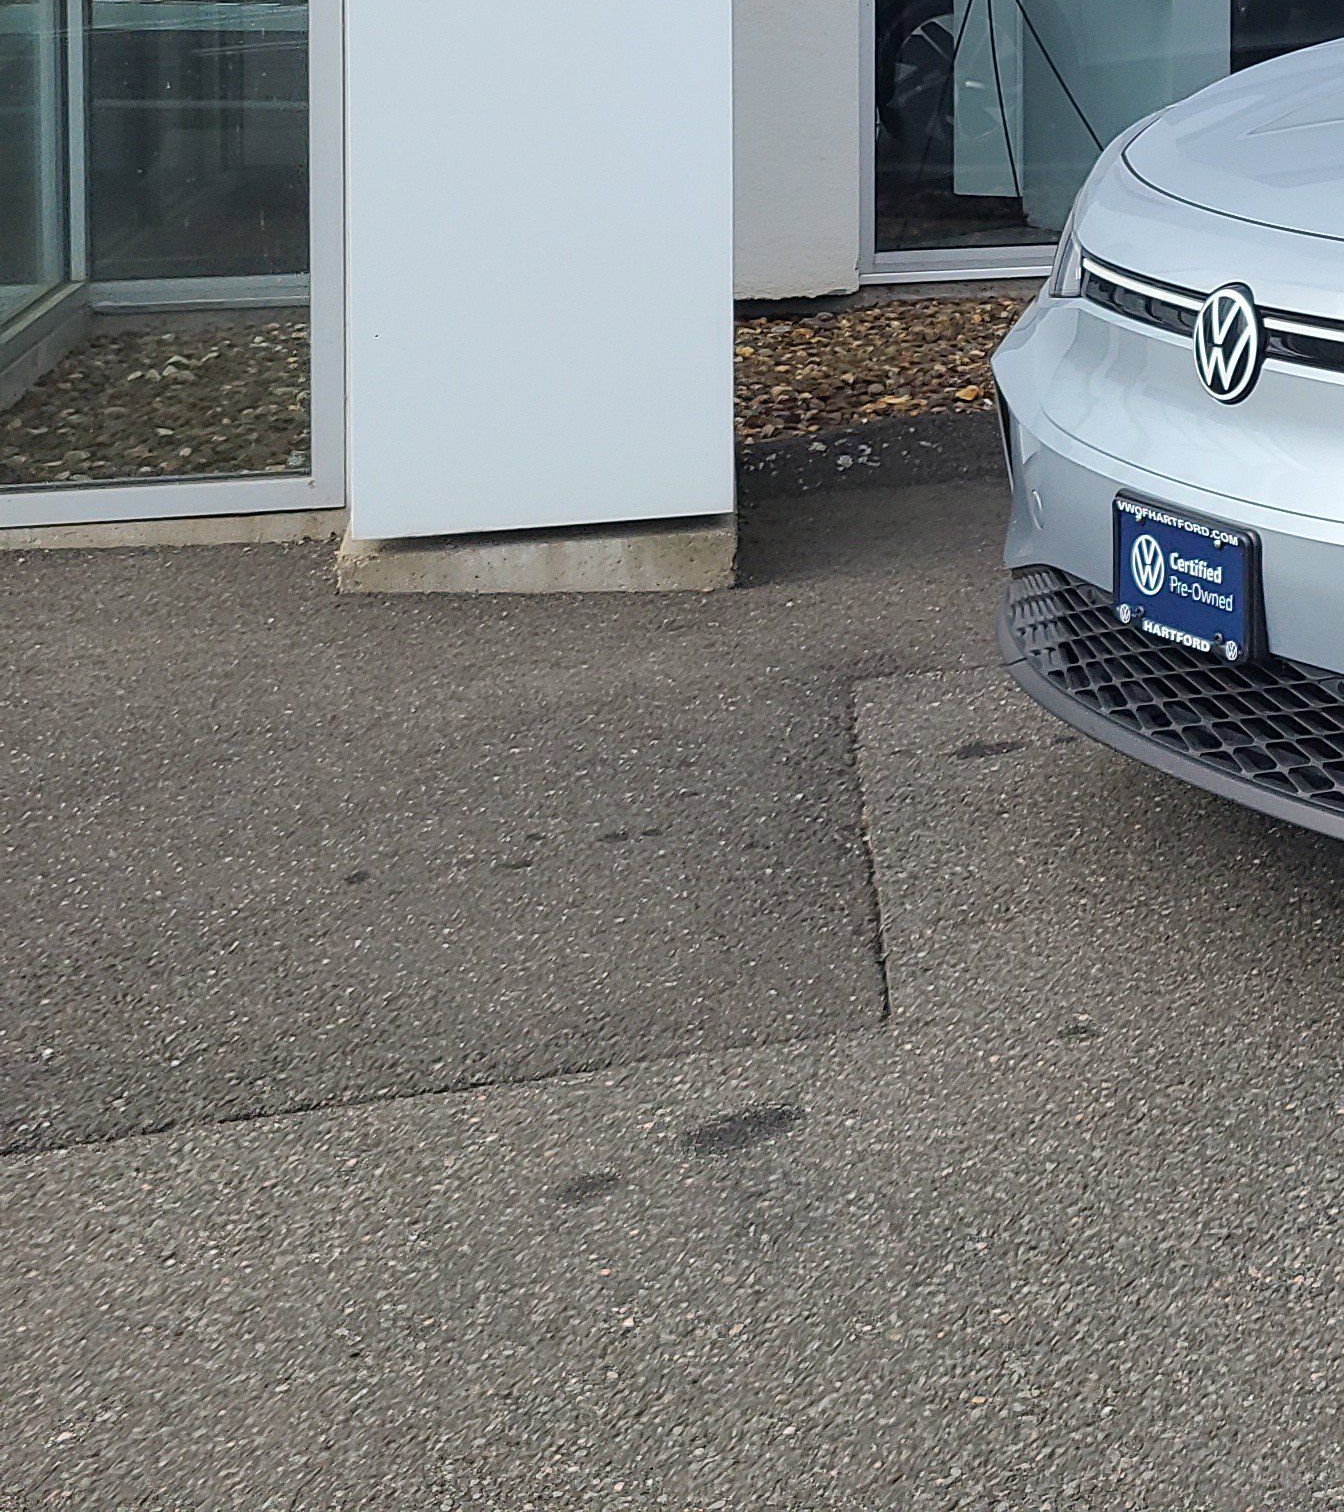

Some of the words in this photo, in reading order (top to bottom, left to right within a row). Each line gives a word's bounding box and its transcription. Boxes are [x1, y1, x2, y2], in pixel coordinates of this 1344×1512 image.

[1169, 552, 1222, 584] Certified
[1169, 575, 1234, 612] Pre-Owned
[1142, 619, 1211, 653] HARTFORD
